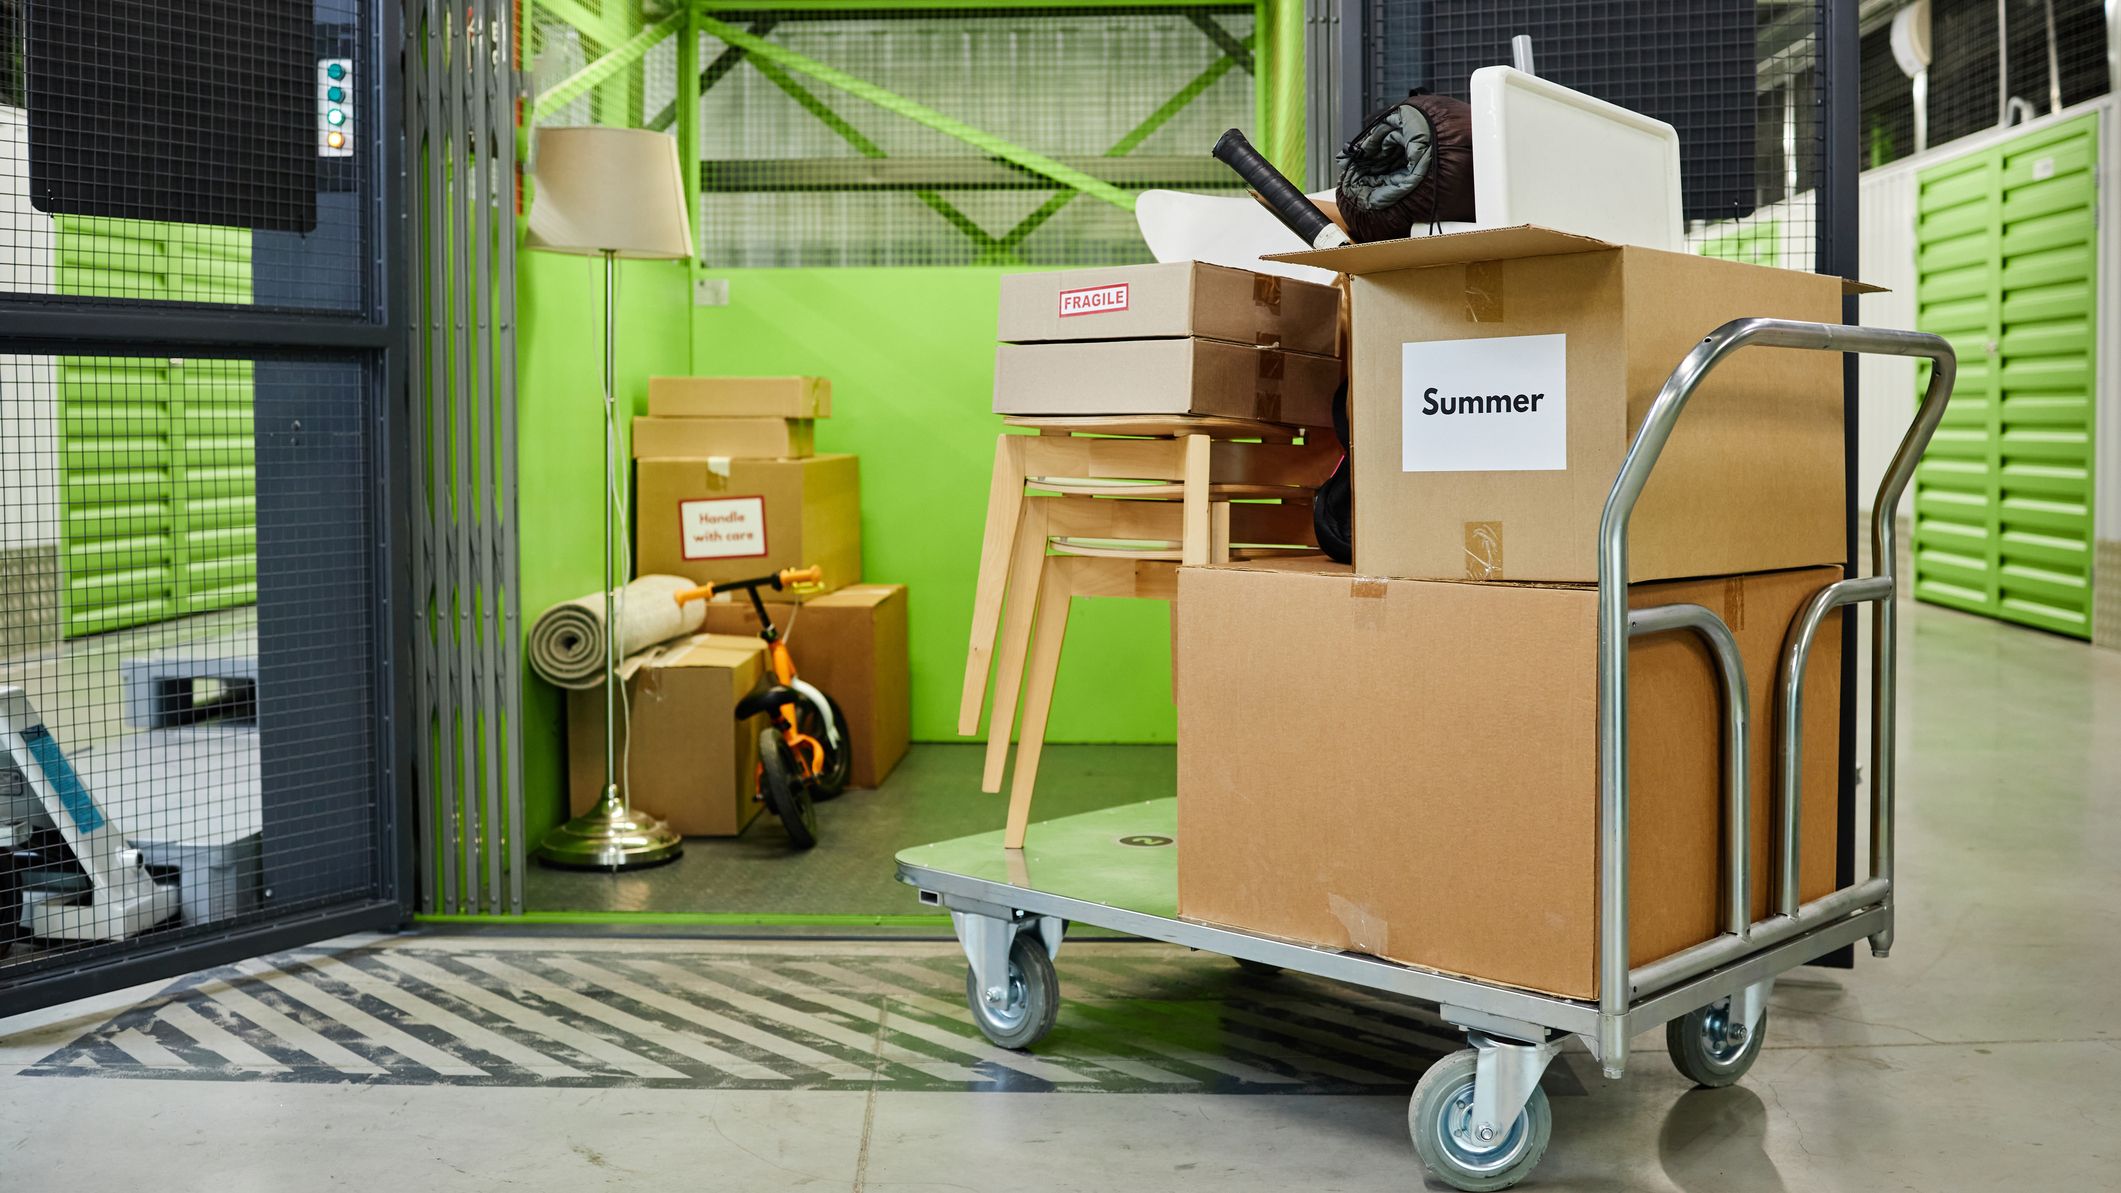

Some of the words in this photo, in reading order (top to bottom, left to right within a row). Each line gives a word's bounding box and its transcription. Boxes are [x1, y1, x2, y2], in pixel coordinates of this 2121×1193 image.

[1064, 290, 1124, 310] FRAGILE
[1422, 387, 1545, 415] Summer
[699, 511, 745, 524] Handle
[693, 530, 722, 542] with
[726, 531, 754, 541] care
